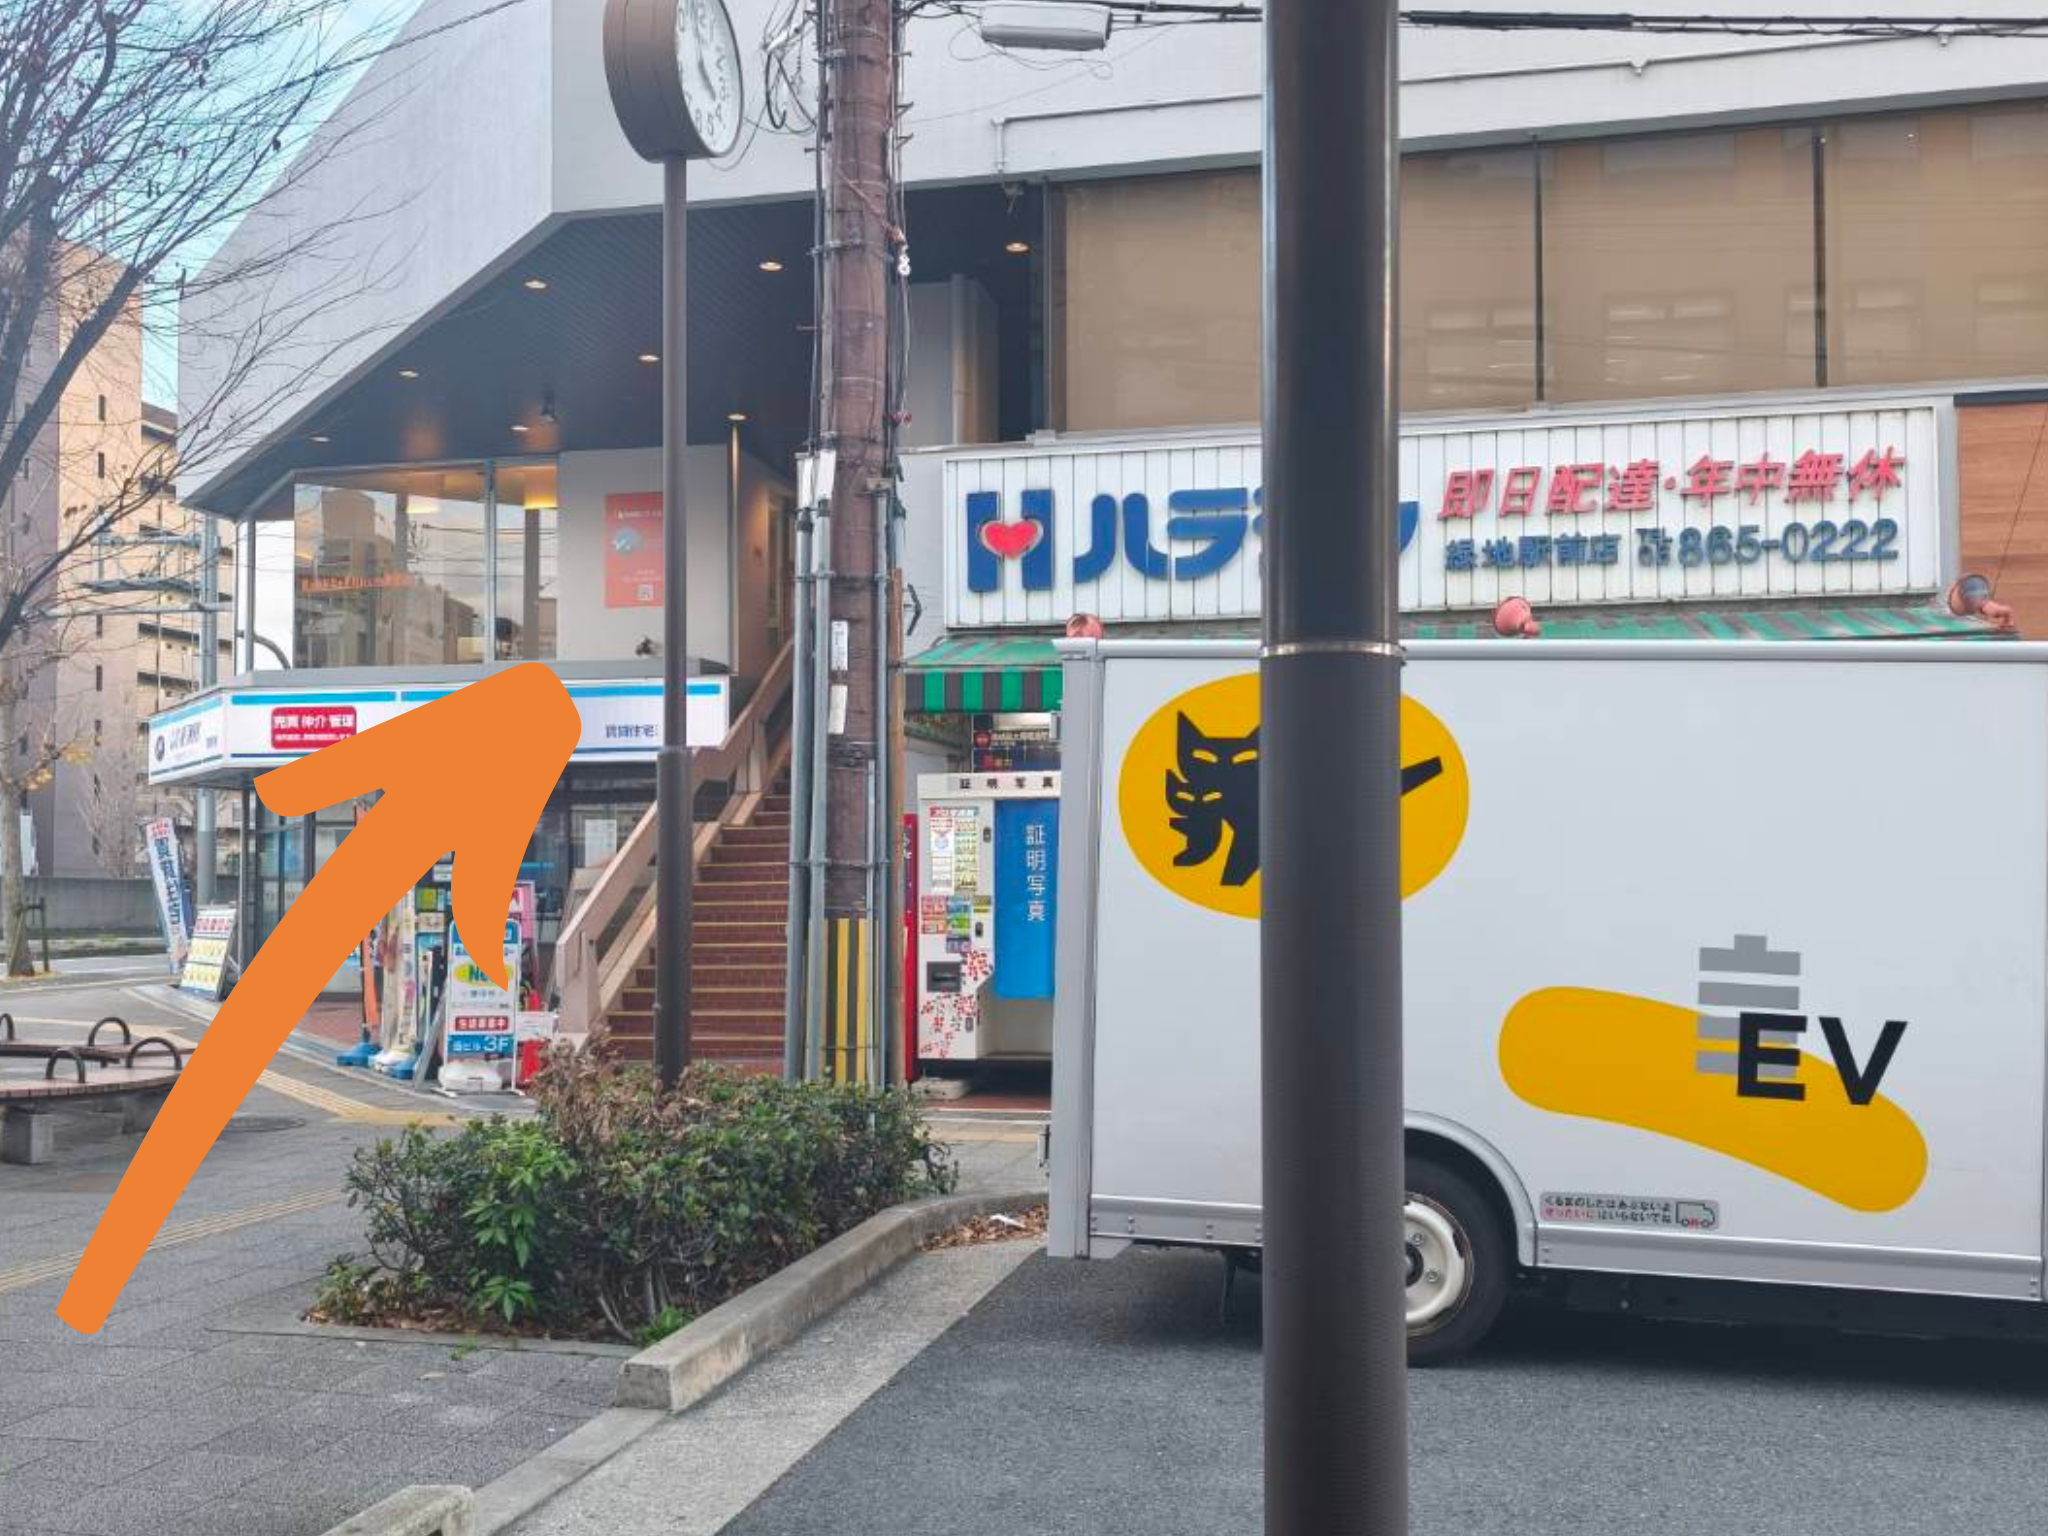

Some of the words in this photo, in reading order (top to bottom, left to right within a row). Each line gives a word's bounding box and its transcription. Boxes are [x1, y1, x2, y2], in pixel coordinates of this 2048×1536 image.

[1678, 518, 1899, 568] 865-0222
[1025, 824, 1047, 922] 証明写真
[483, 1036, 509, 1052] 3F
[1736, 1012, 1908, 1106] EV
